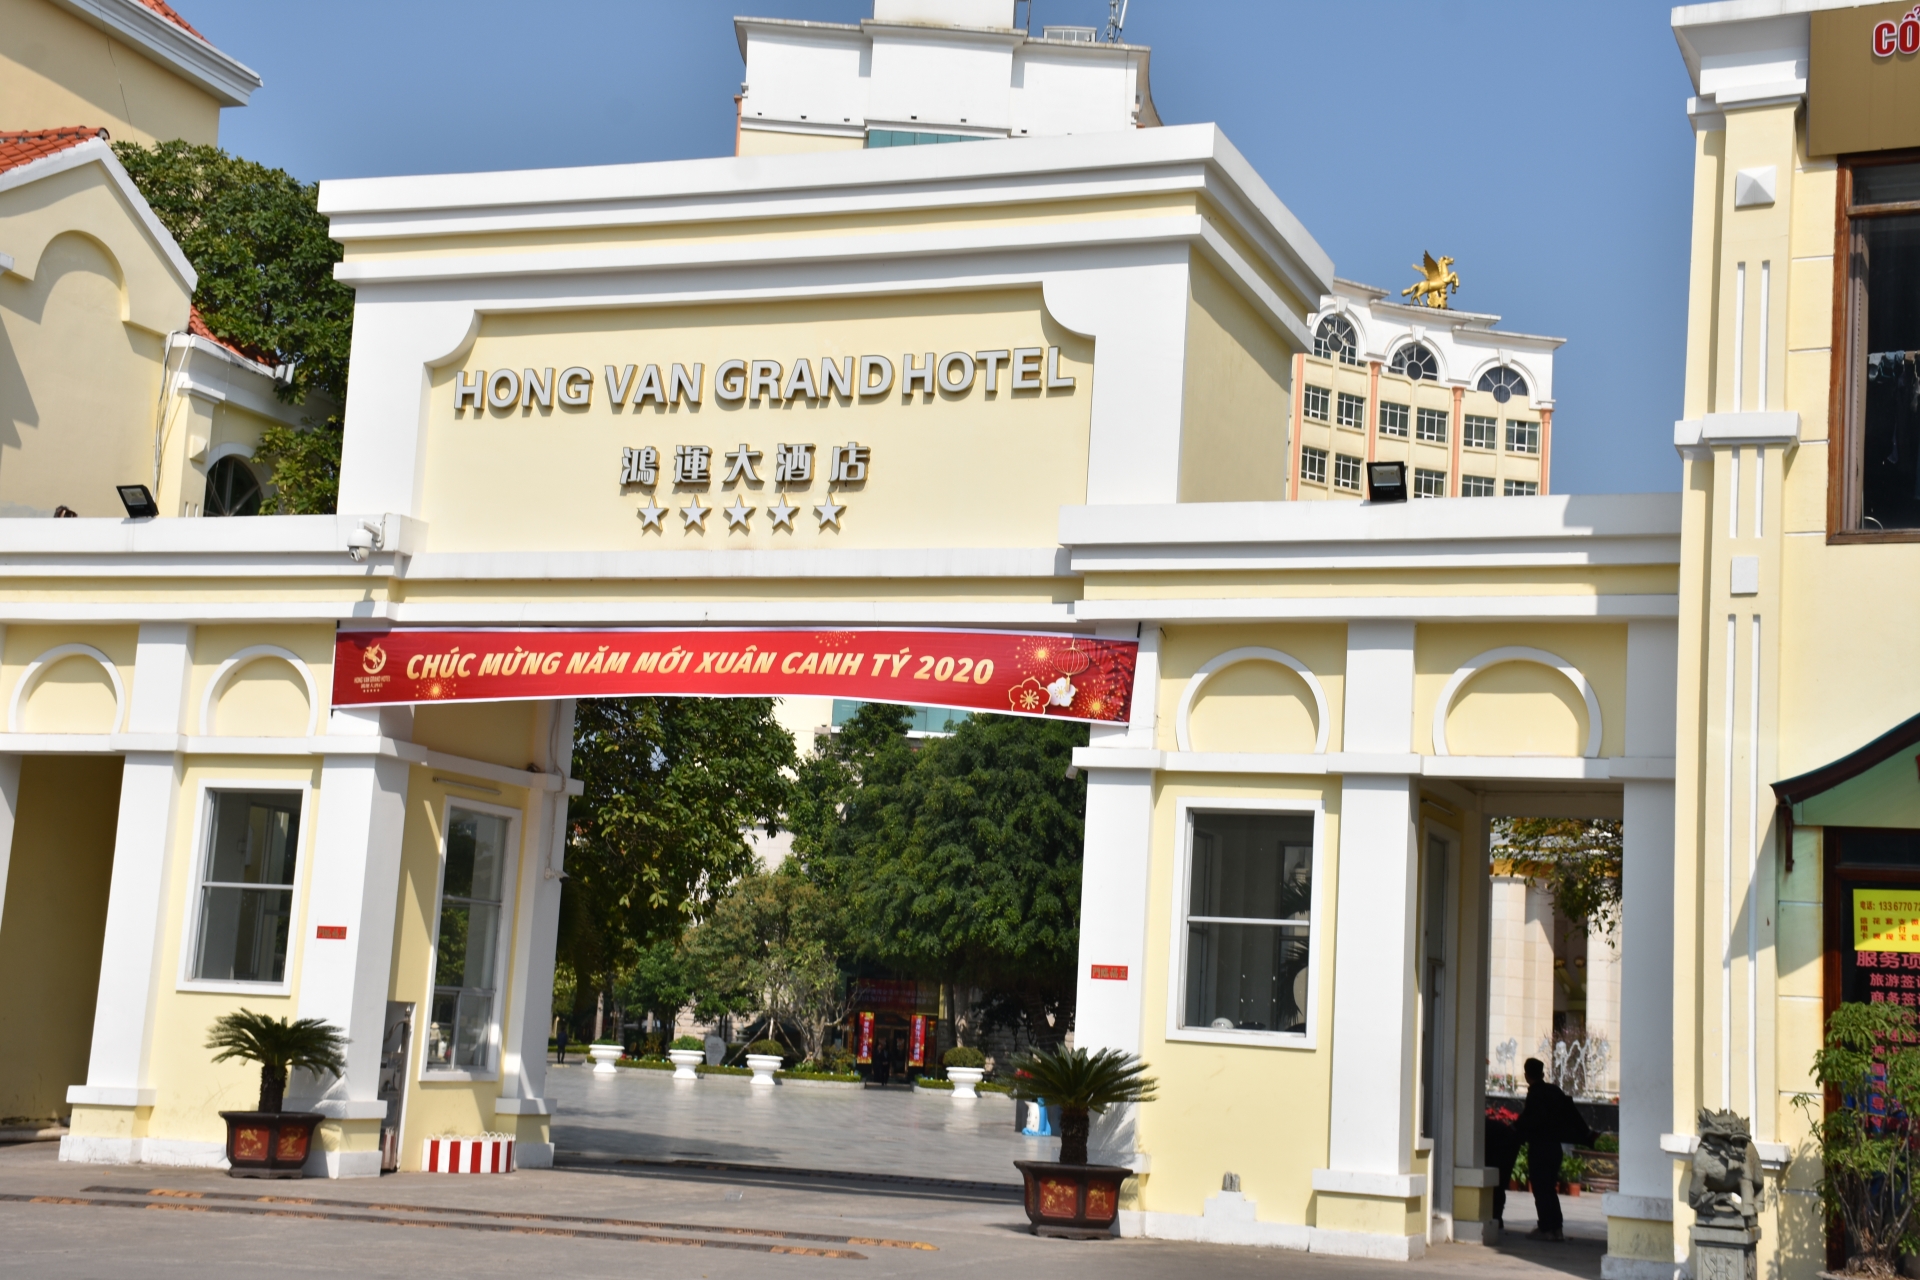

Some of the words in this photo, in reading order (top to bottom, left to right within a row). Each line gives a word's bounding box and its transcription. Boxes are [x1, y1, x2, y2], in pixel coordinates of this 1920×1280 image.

[454, 366, 593, 411] HONG
[604, 362, 706, 407] VAN
[714, 355, 895, 402] GRAND
[902, 346, 1076, 397] HOTEL
[619, 441, 871, 487] 鴻運大酒店
[406, 646, 476, 680] CHÚC
[477, 645, 563, 676] MỪNG
[565, 645, 632, 674] NĂM
[632, 645, 694, 674] MỚI
[694, 644, 778, 674] XUÂN
[781, 651, 865, 676] CANH
[871, 647, 912, 678] TÝ
[914, 655, 994, 685] 2020
